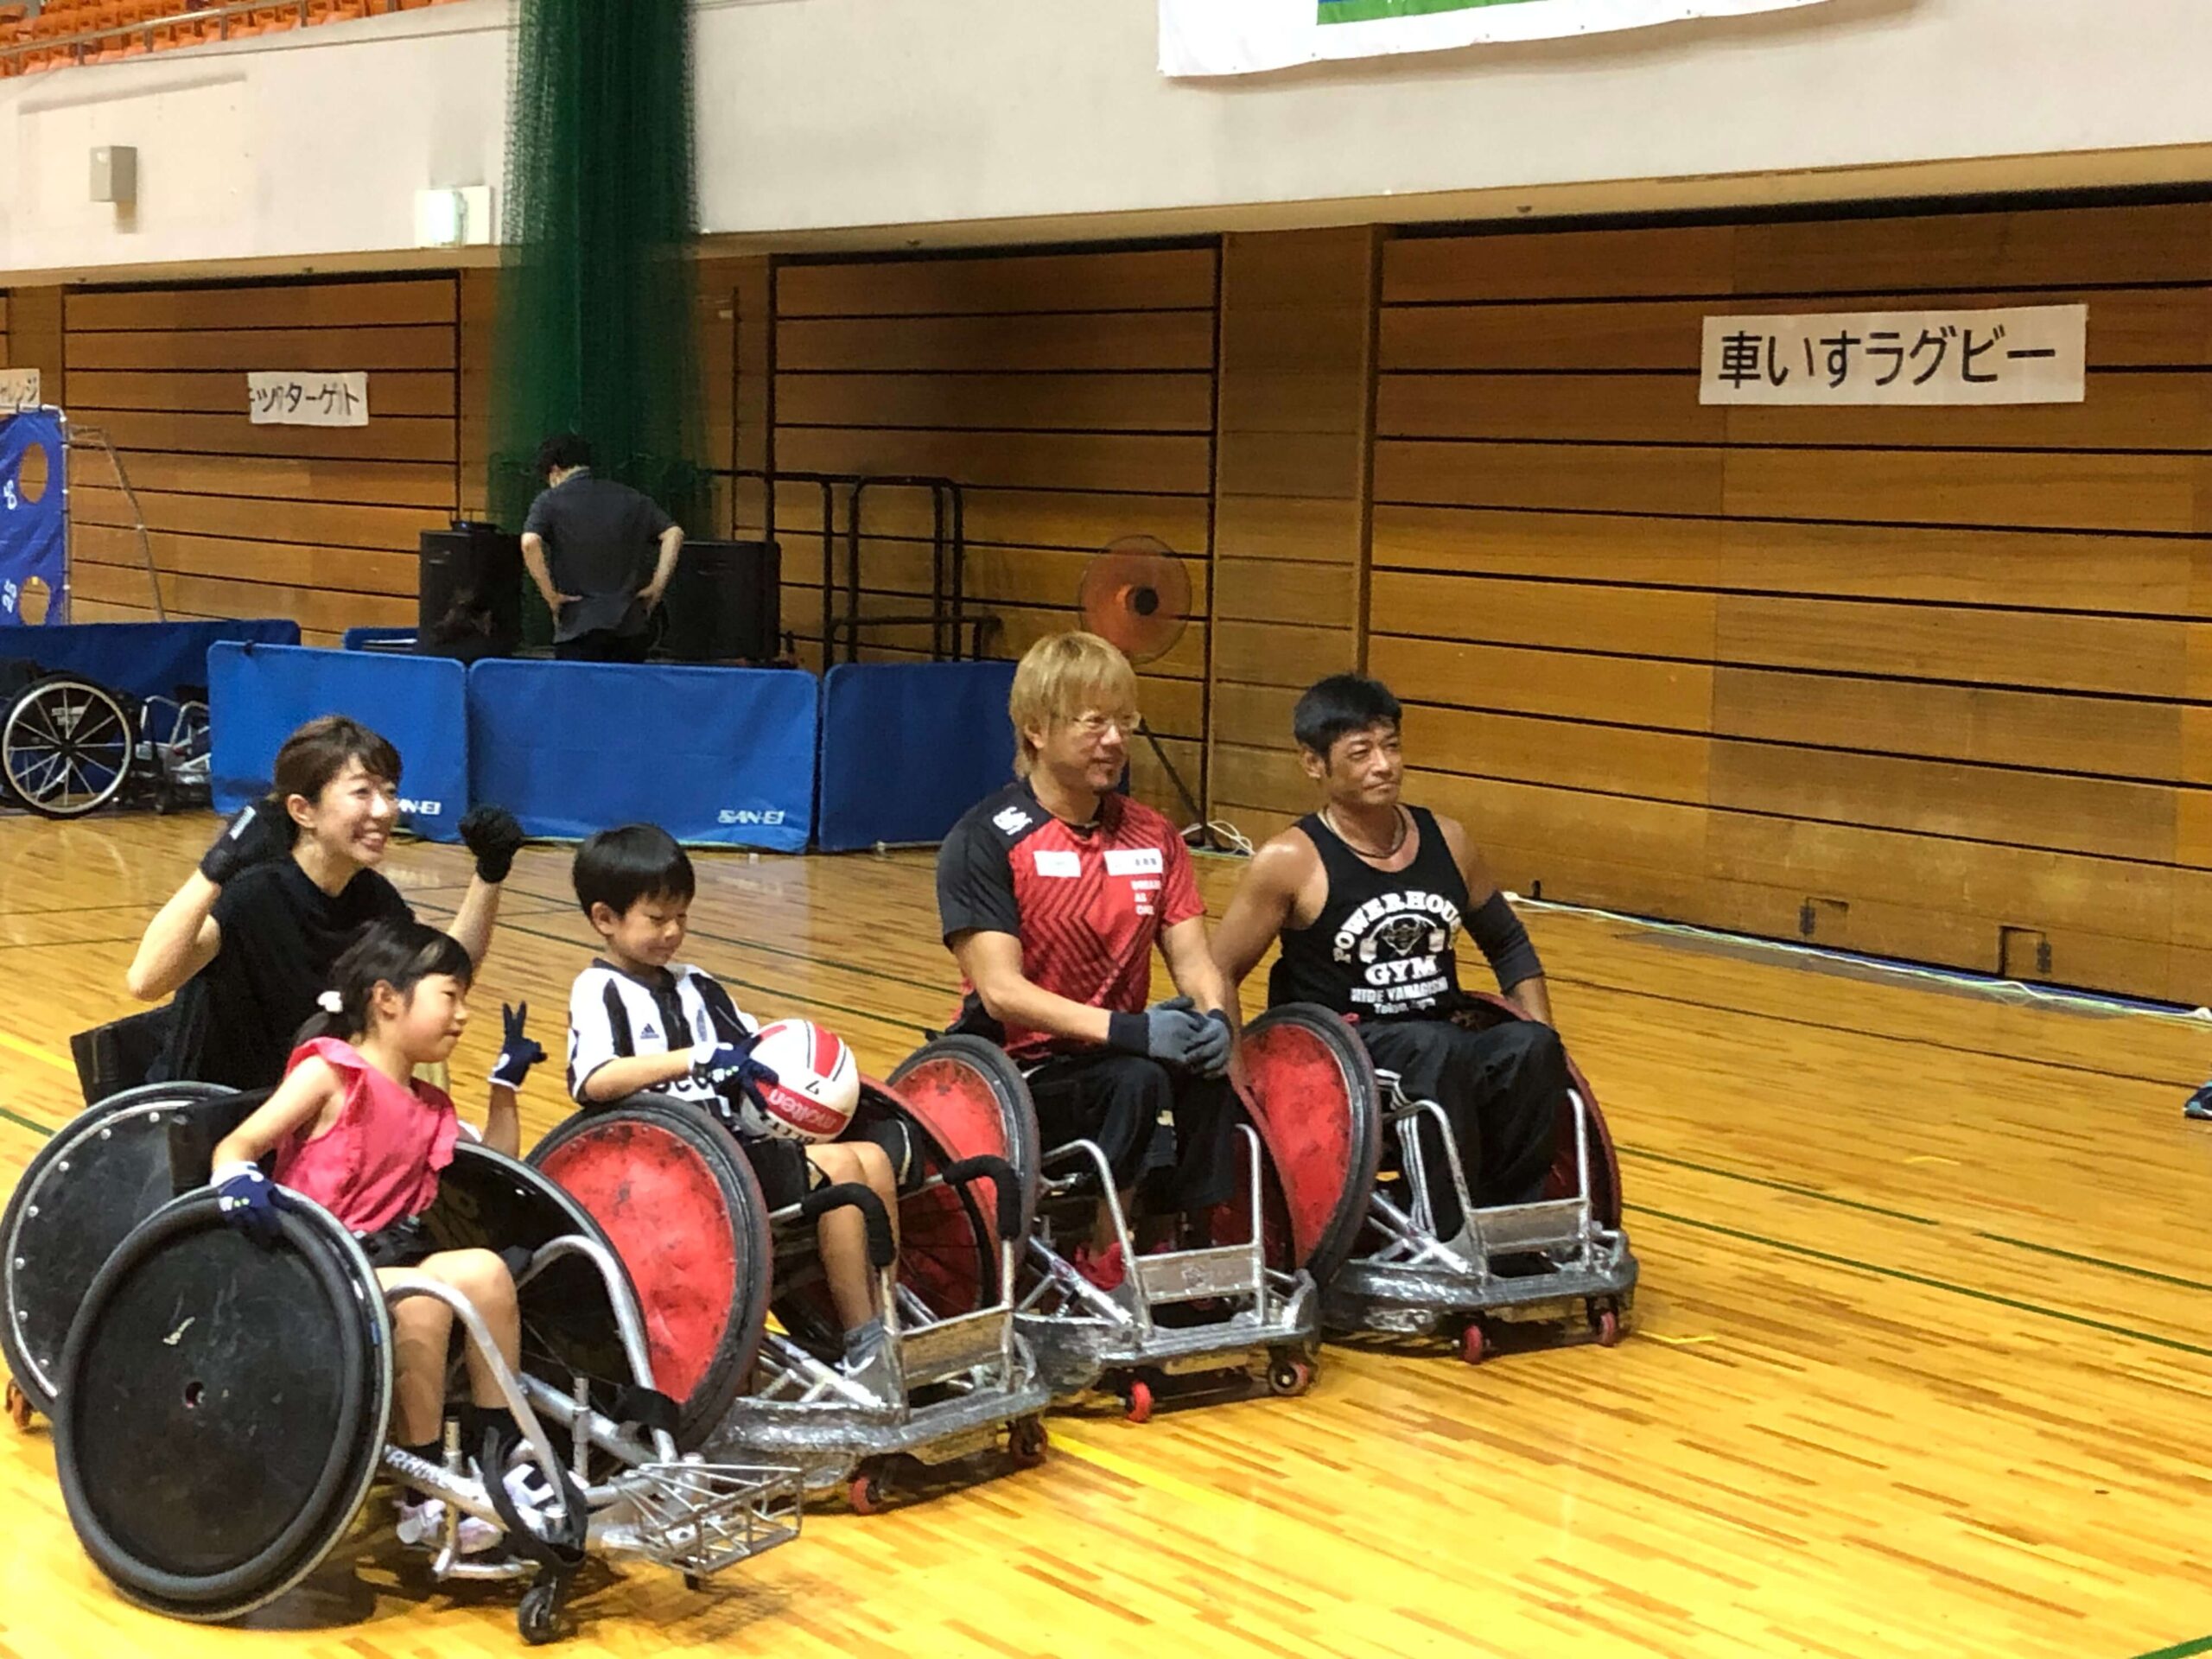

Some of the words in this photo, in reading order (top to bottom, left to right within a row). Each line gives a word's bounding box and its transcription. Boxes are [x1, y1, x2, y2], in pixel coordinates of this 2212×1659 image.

[1718, 325, 2056, 389] 車いすラグビー
[1364, 955, 1439, 986] GYM
[769, 1089, 837, 1128] molten
